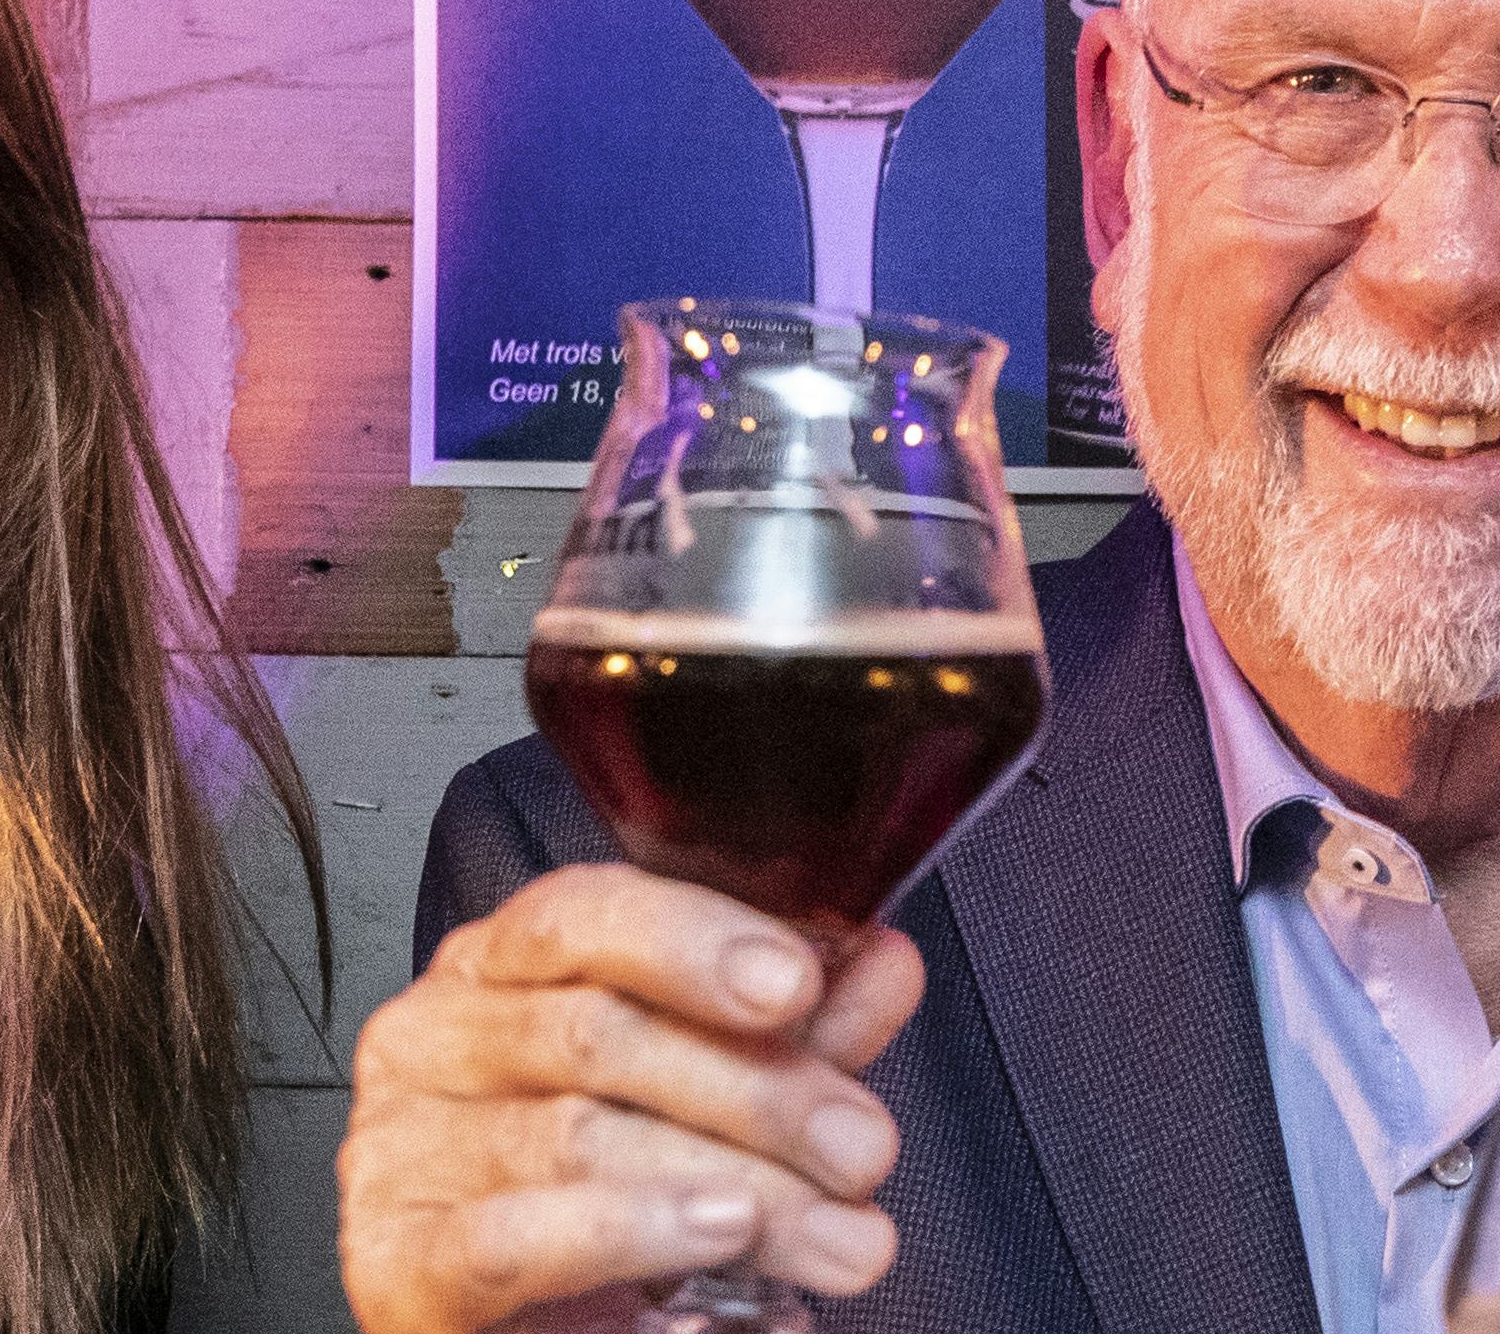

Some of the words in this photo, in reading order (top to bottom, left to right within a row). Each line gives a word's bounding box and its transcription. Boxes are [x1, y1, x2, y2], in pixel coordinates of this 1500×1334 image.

[490, 339, 537, 365] Met
[544, 339, 601, 366] trots
[489, 377, 559, 404] Geen
[569, 380, 605, 406] 18,
